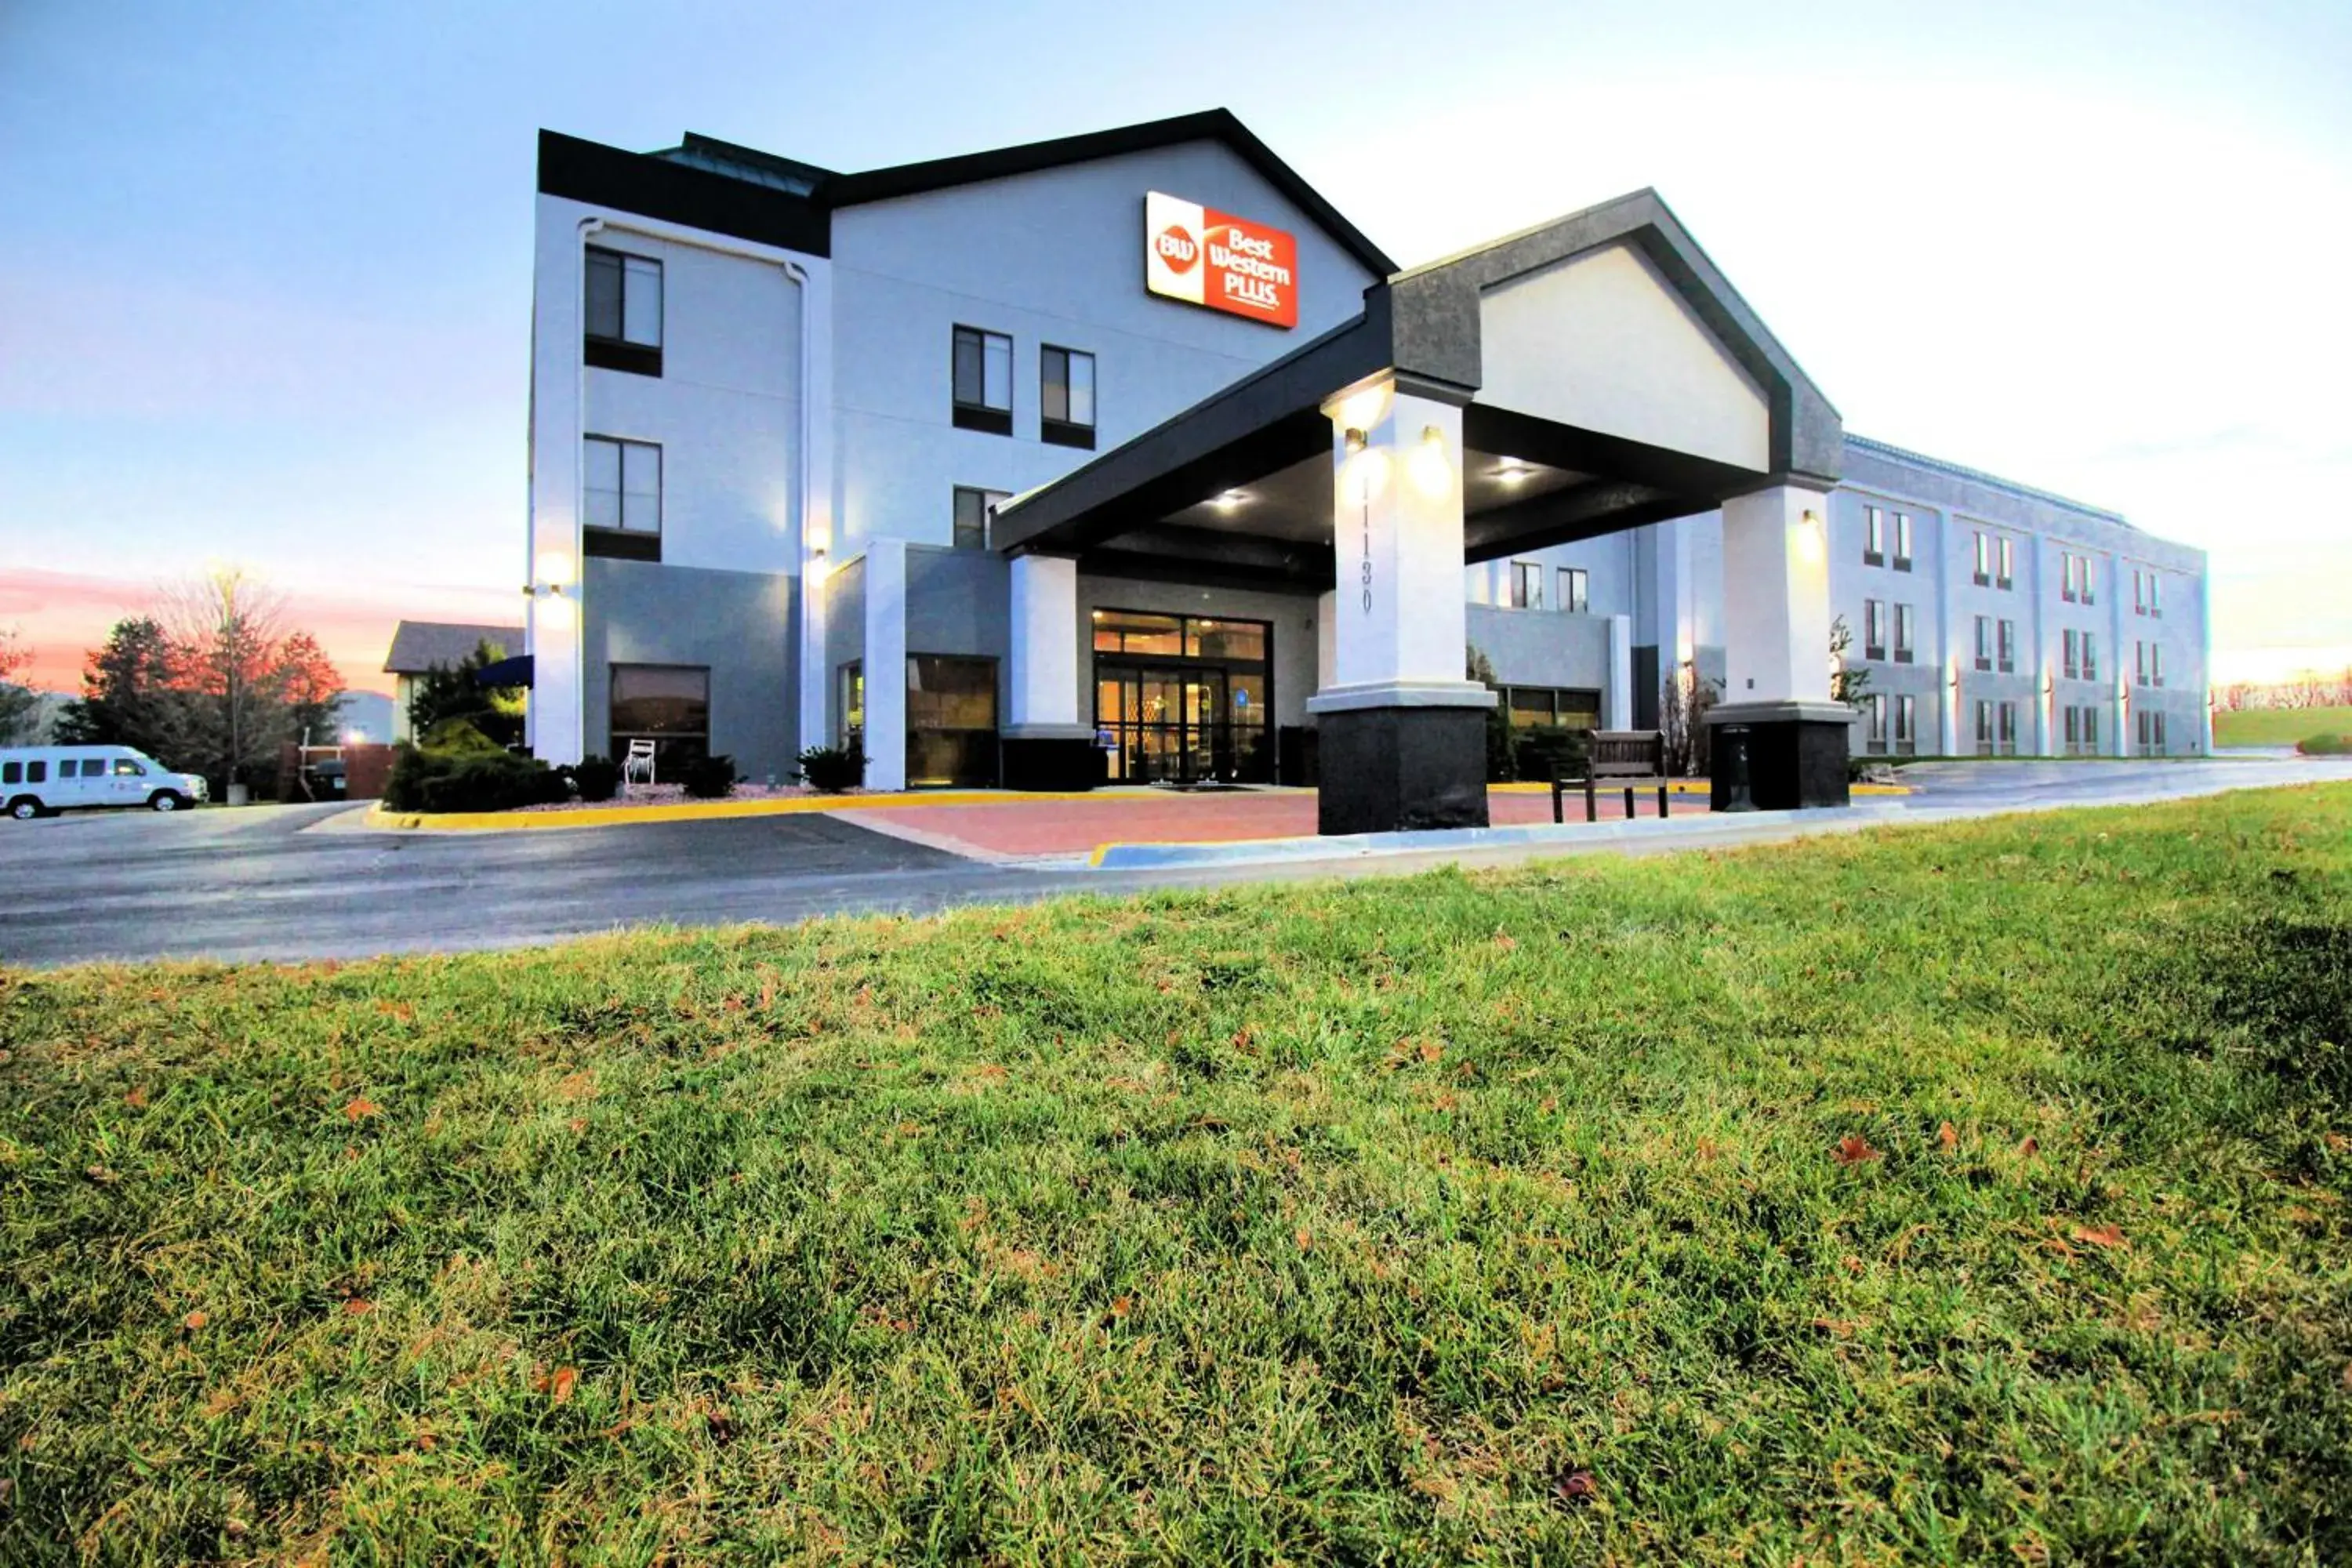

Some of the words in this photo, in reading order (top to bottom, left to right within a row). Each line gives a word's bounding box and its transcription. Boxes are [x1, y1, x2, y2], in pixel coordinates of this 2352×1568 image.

[1160, 234, 1194, 261] BW
[1228, 228, 1273, 260] Best
[1209, 243, 1290, 285] Western
[1224, 271, 1276, 304] PLUS
[1361, 474, 1373, 615] 11130
